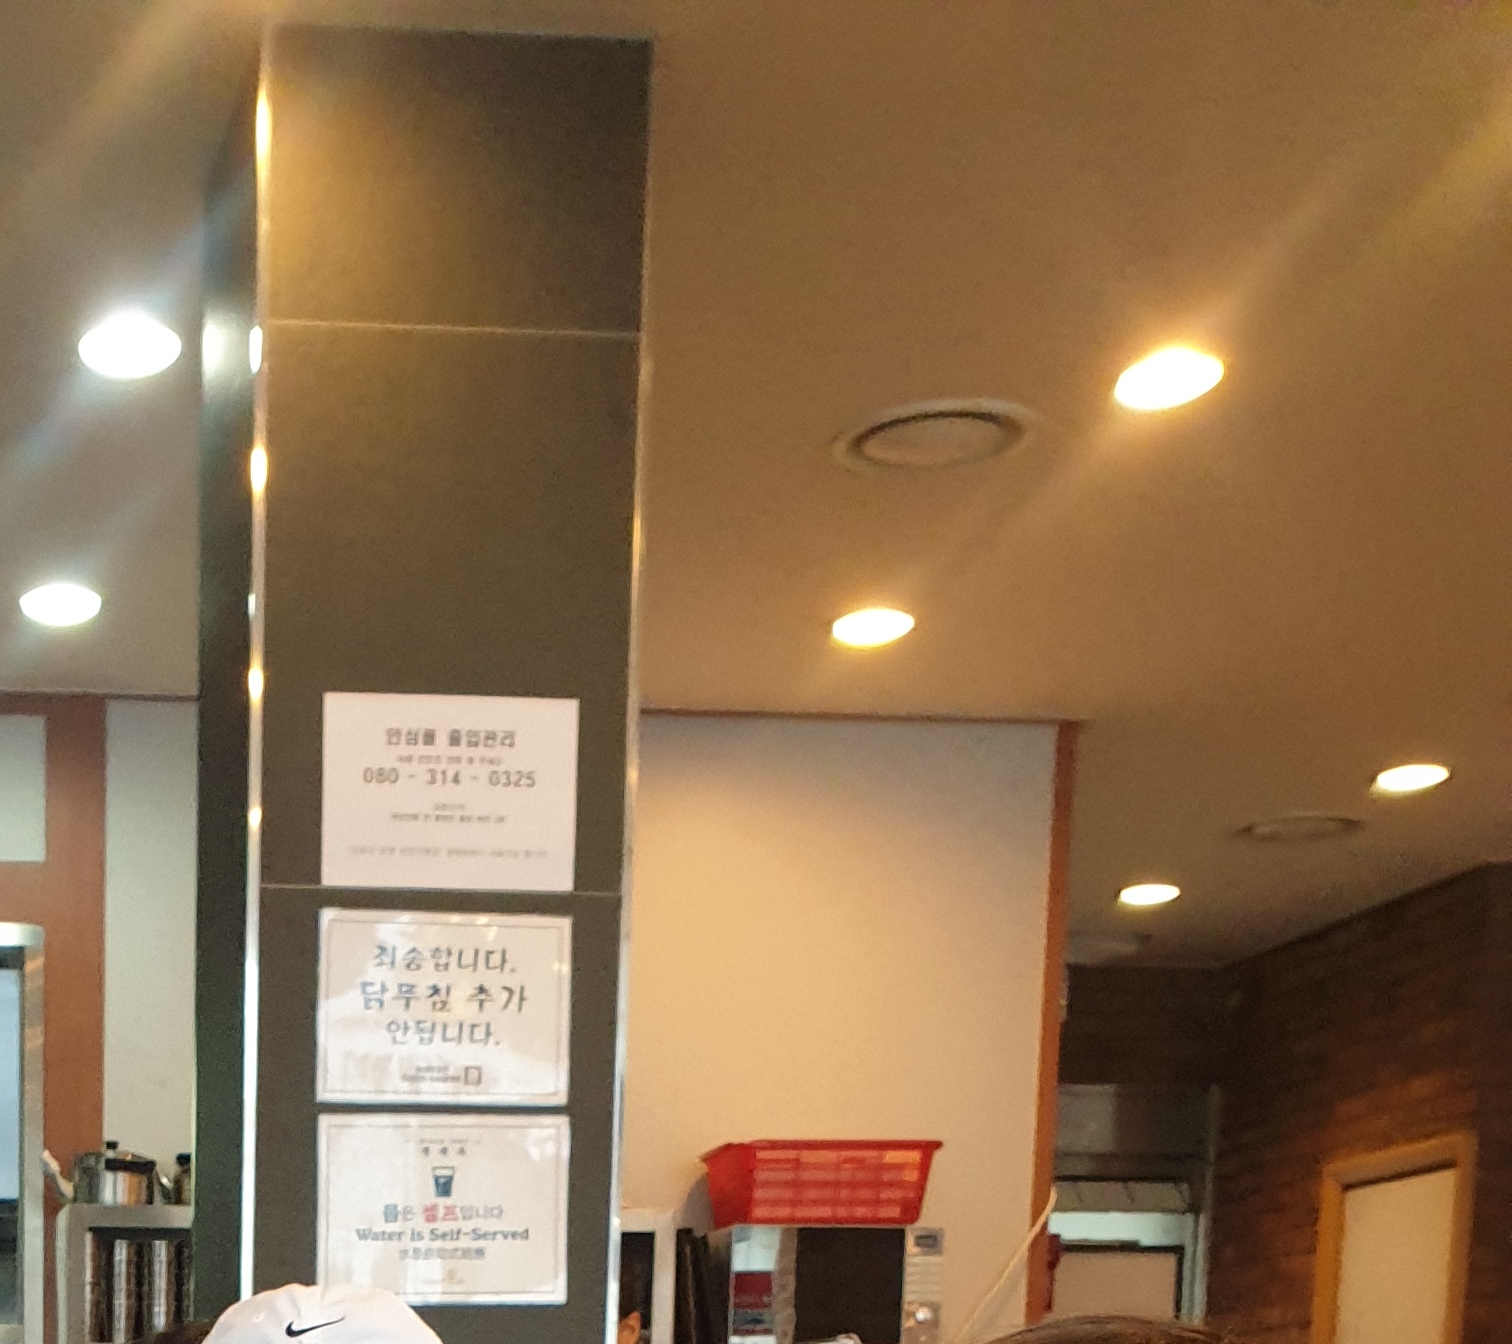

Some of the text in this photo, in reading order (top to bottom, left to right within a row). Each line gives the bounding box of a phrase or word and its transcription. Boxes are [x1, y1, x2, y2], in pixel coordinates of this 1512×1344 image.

[373, 944, 517, 973] 죄송합니다.
[466, 983, 529, 1014] 추가
[384, 1018, 501, 1047] 안됩니다.
[355, 1228, 404, 1242] Water
[429, 1227, 530, 1242] Self-Served
